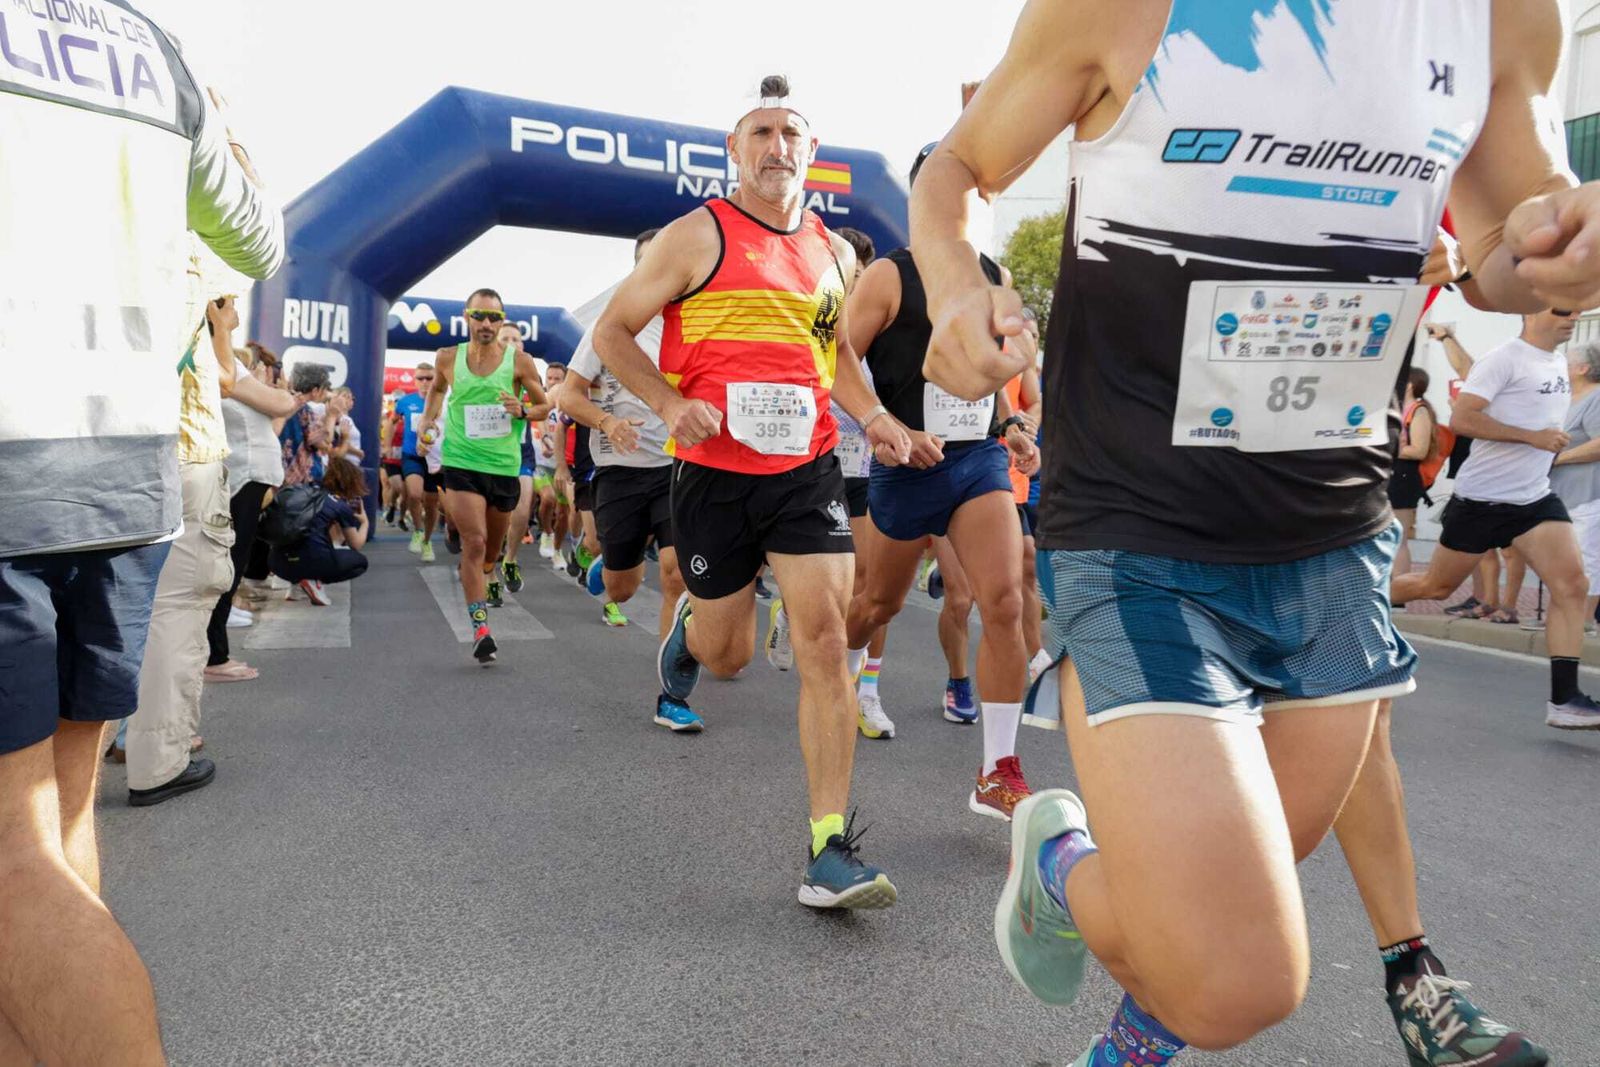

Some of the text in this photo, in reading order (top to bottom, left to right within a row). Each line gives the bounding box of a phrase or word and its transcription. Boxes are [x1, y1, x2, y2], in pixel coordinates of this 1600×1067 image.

[120, 16, 154, 49] DE
[510, 116, 738, 181] POLICI
[1245, 133, 1446, 184] TrailRunner
[1321, 187, 1387, 205] STORE
[282, 298, 350, 345] RUTA
[1266, 376, 1321, 413] 85
[755, 422, 791, 438] 395
[949, 413, 980, 427] 242
